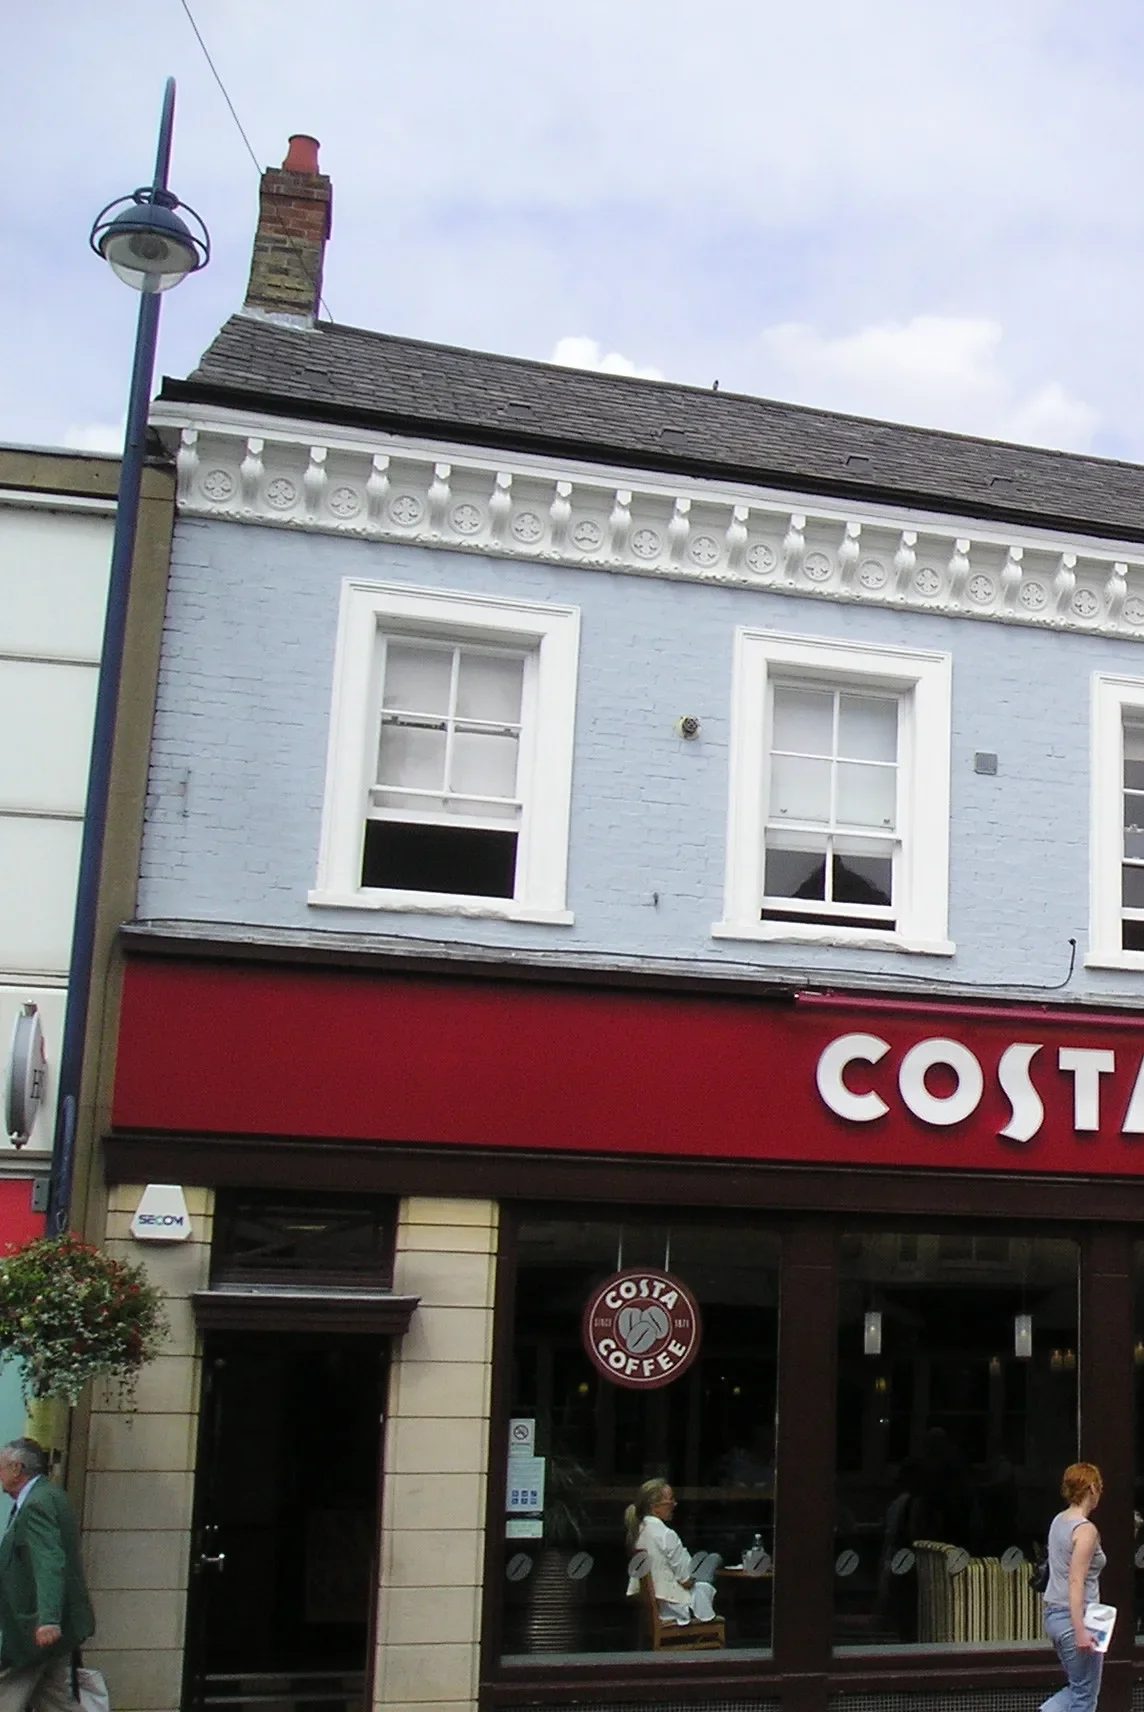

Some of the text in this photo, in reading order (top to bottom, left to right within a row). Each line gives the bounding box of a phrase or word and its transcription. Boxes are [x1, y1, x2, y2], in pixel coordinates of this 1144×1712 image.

[138, 1214, 184, 1226] SECOM
[604, 1278, 679, 1310] COSTA
[598, 1338, 687, 1377] COFFEE
